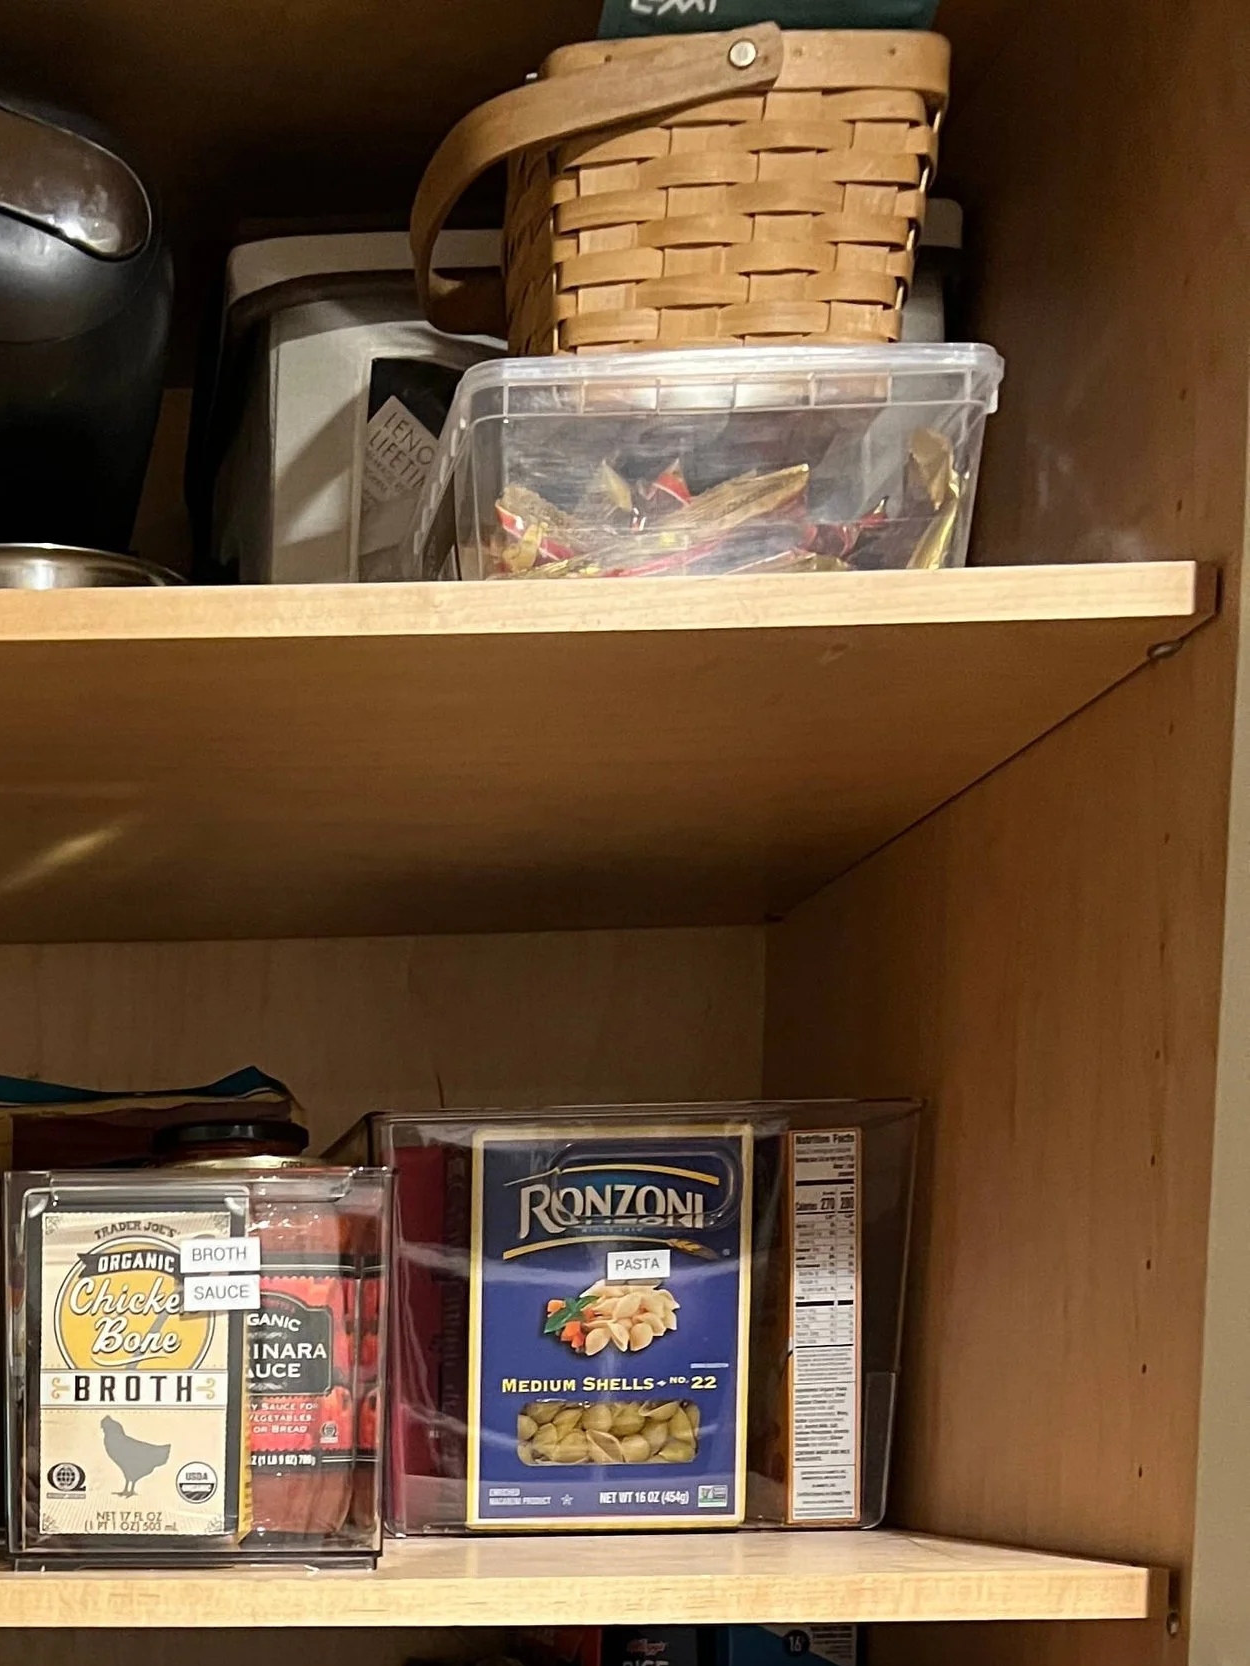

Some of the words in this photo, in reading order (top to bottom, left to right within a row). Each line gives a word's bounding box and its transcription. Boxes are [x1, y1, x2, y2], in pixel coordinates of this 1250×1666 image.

[519, 1183, 704, 1239] RONZONI
[94, 1220, 142, 1239] TRADER
[98, 1252, 175, 1274] ORGANIC
[192, 1247, 247, 1262] BROTH
[615, 1258, 660, 1271] PASTA
[70, 1276, 184, 1316] Chicke
[193, 1284, 250, 1299] SAUCE
[92, 1317, 182, 1353] Bone
[253, 1343, 327, 1359] INARA
[74, 1375, 193, 1402] BROTH
[502, 1378, 576, 1393] MEDIUM
[582, 1376, 654, 1392] SHELLS
[691, 1376, 717, 1389] 22
[600, 1491, 618, 1504] NET
[619, 1491, 633, 1504] WT
[635, 1491, 646, 1503] 16
[647, 1491, 659, 1503] OZ
[661, 1490, 690, 1505] (454g)
[96, 1511, 115, 1521] NET
[120, 1511, 131, 1521] 17
[133, 1511, 144, 1521] FL
[146, 1511, 162, 1521] OZ
